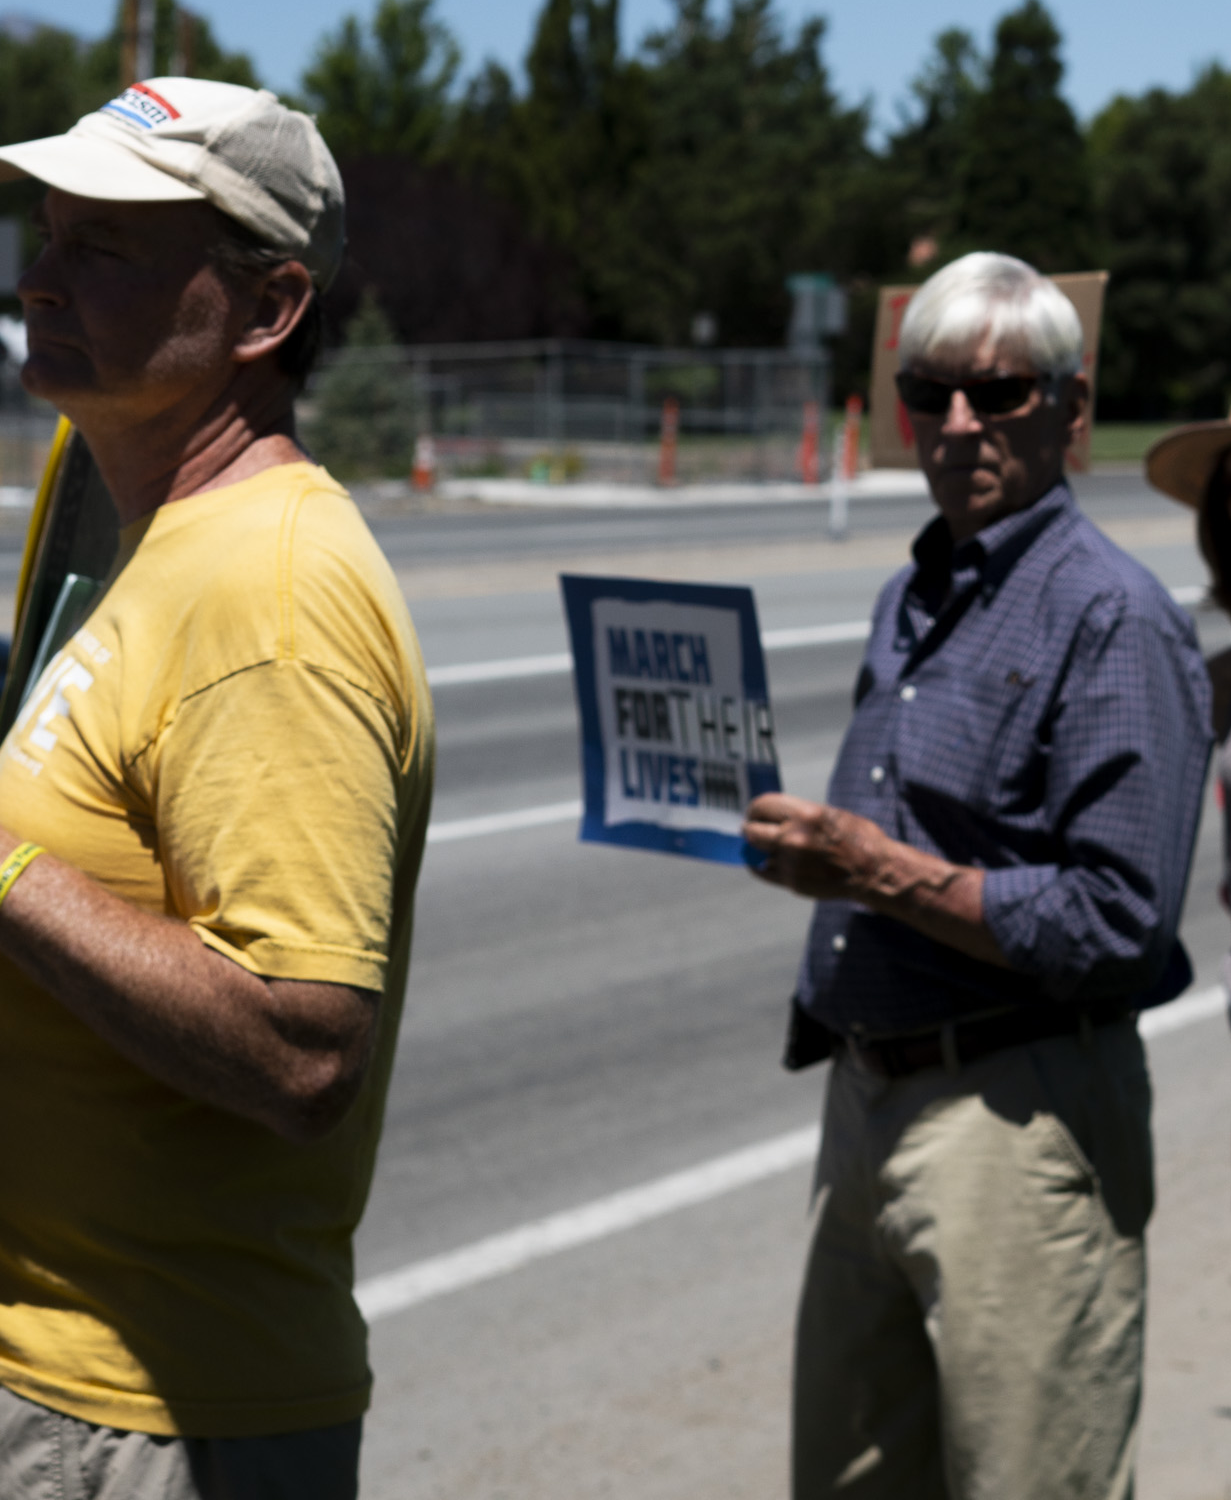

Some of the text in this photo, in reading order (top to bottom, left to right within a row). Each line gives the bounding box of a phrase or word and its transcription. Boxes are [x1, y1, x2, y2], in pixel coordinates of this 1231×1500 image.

[606, 626, 712, 685] MARCH
[614, 687, 778, 764] FOR THEIR
[620, 747, 700, 807] LIVES
